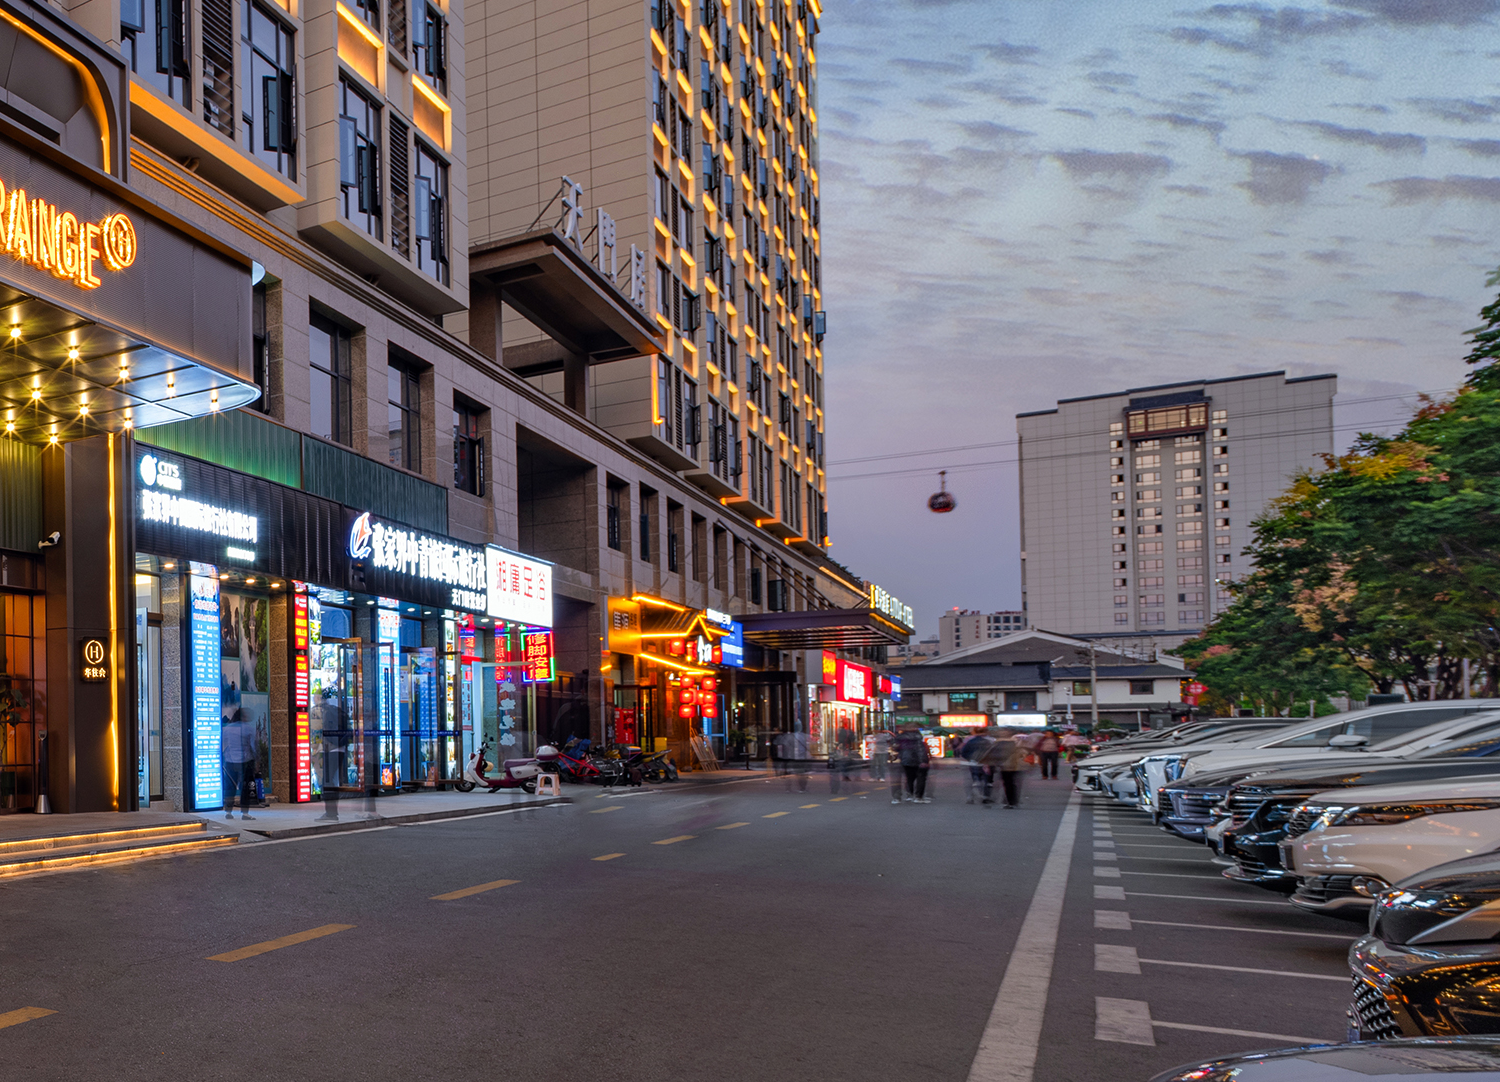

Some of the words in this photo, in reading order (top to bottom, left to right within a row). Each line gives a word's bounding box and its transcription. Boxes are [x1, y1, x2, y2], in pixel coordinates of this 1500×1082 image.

[157, 461, 180, 478] CITS
[84, 667, 107, 678] 华住会
